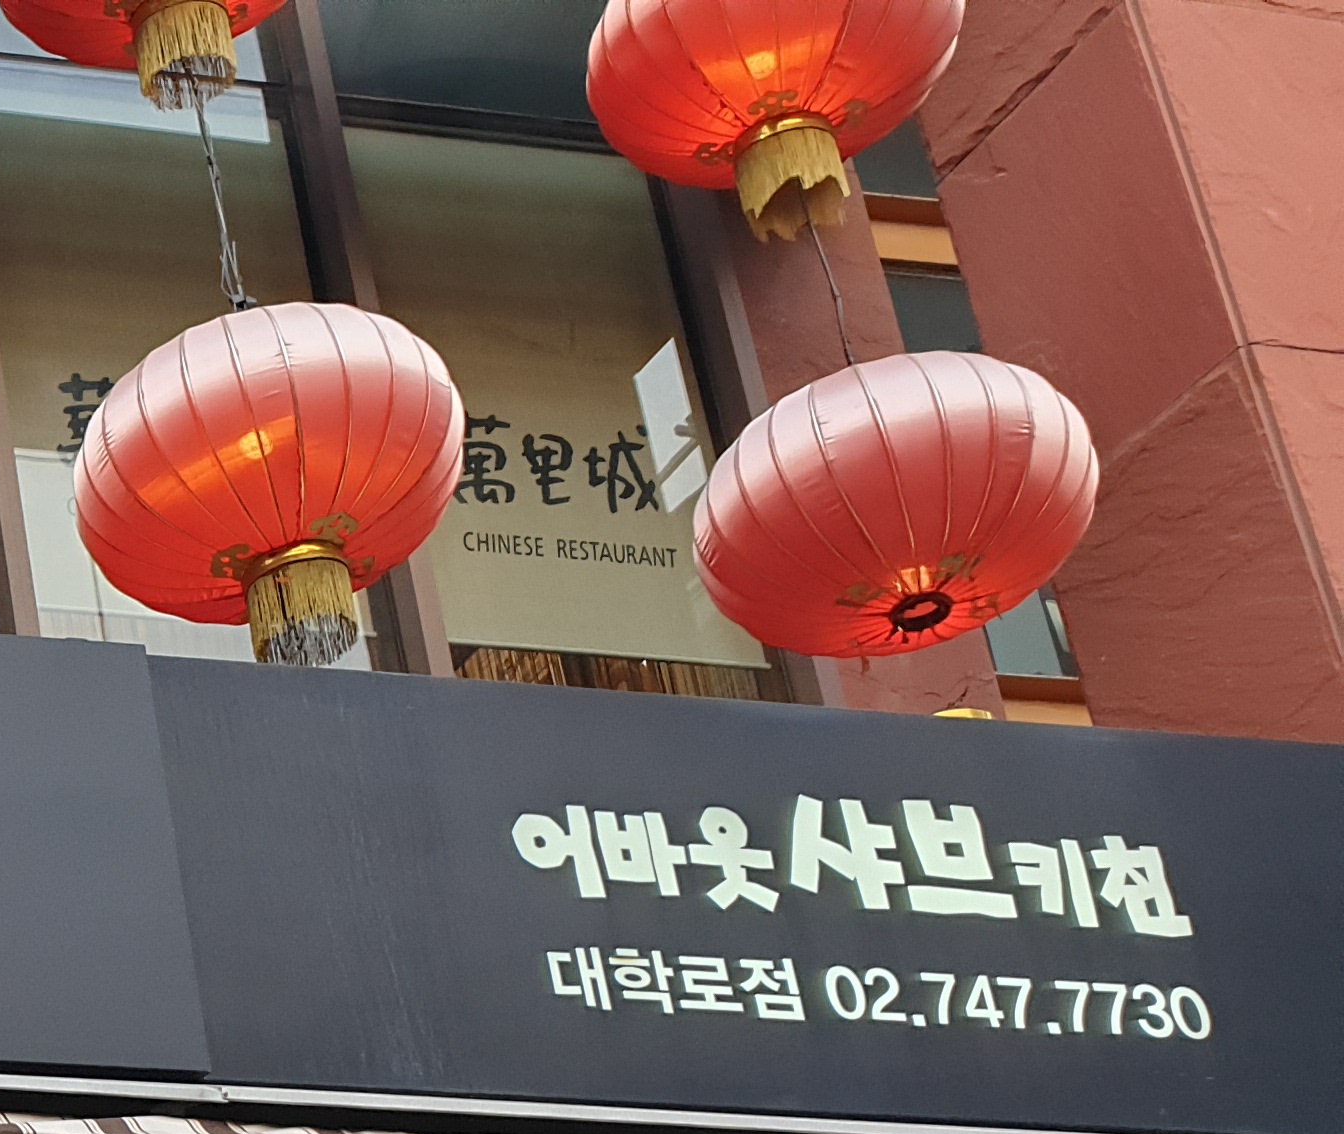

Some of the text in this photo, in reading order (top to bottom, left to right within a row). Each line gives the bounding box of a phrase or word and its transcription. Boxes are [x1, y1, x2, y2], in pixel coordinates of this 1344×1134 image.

[462, 531, 677, 569] CHINESE RESTAURANT
[546, 946, 1213, 1041] 대학로점 02.747.7730
